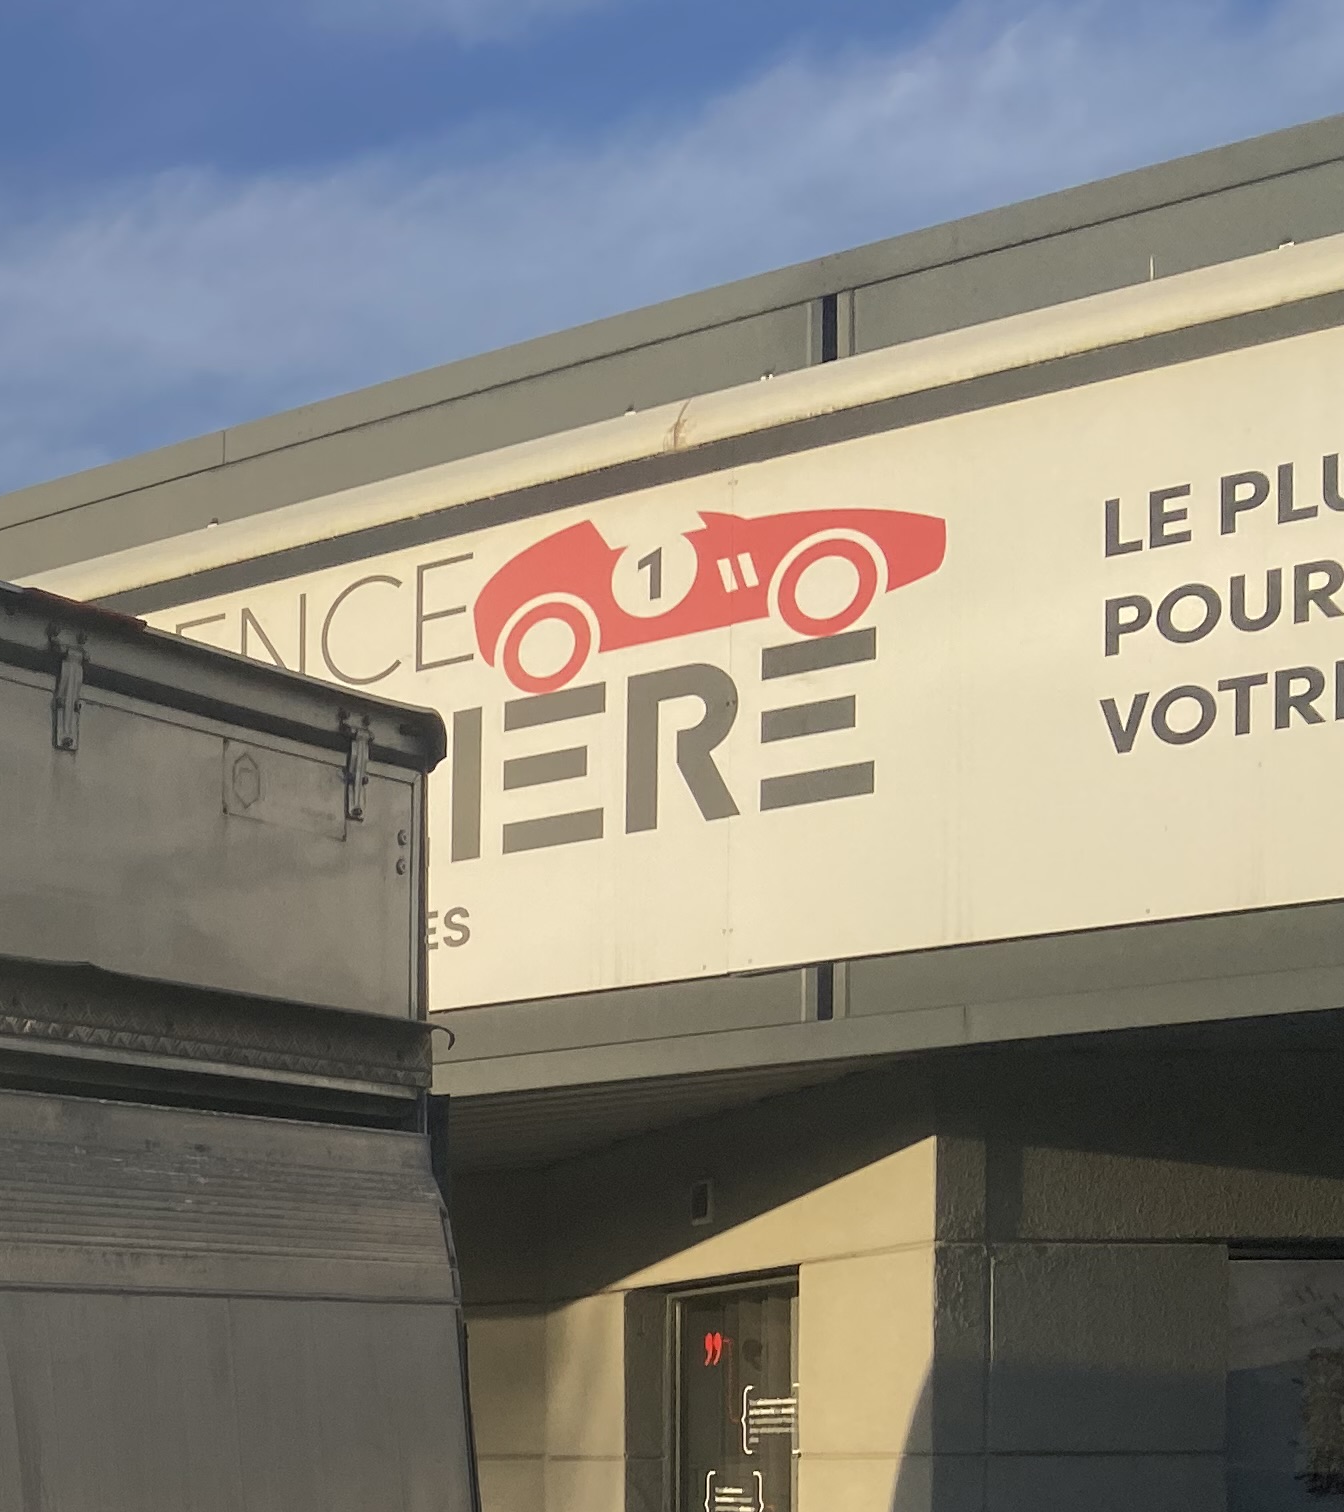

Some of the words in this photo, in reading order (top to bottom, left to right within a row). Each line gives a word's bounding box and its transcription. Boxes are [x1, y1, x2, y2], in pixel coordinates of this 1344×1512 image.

[1105, 483, 1192, 558] LE
[175, 552, 474, 686] NCE
[637, 547, 662, 601] 1
[1105, 559, 1344, 658] POUR
[451, 627, 877, 863] IERE
[1099, 660, 1344, 755] VOTR
